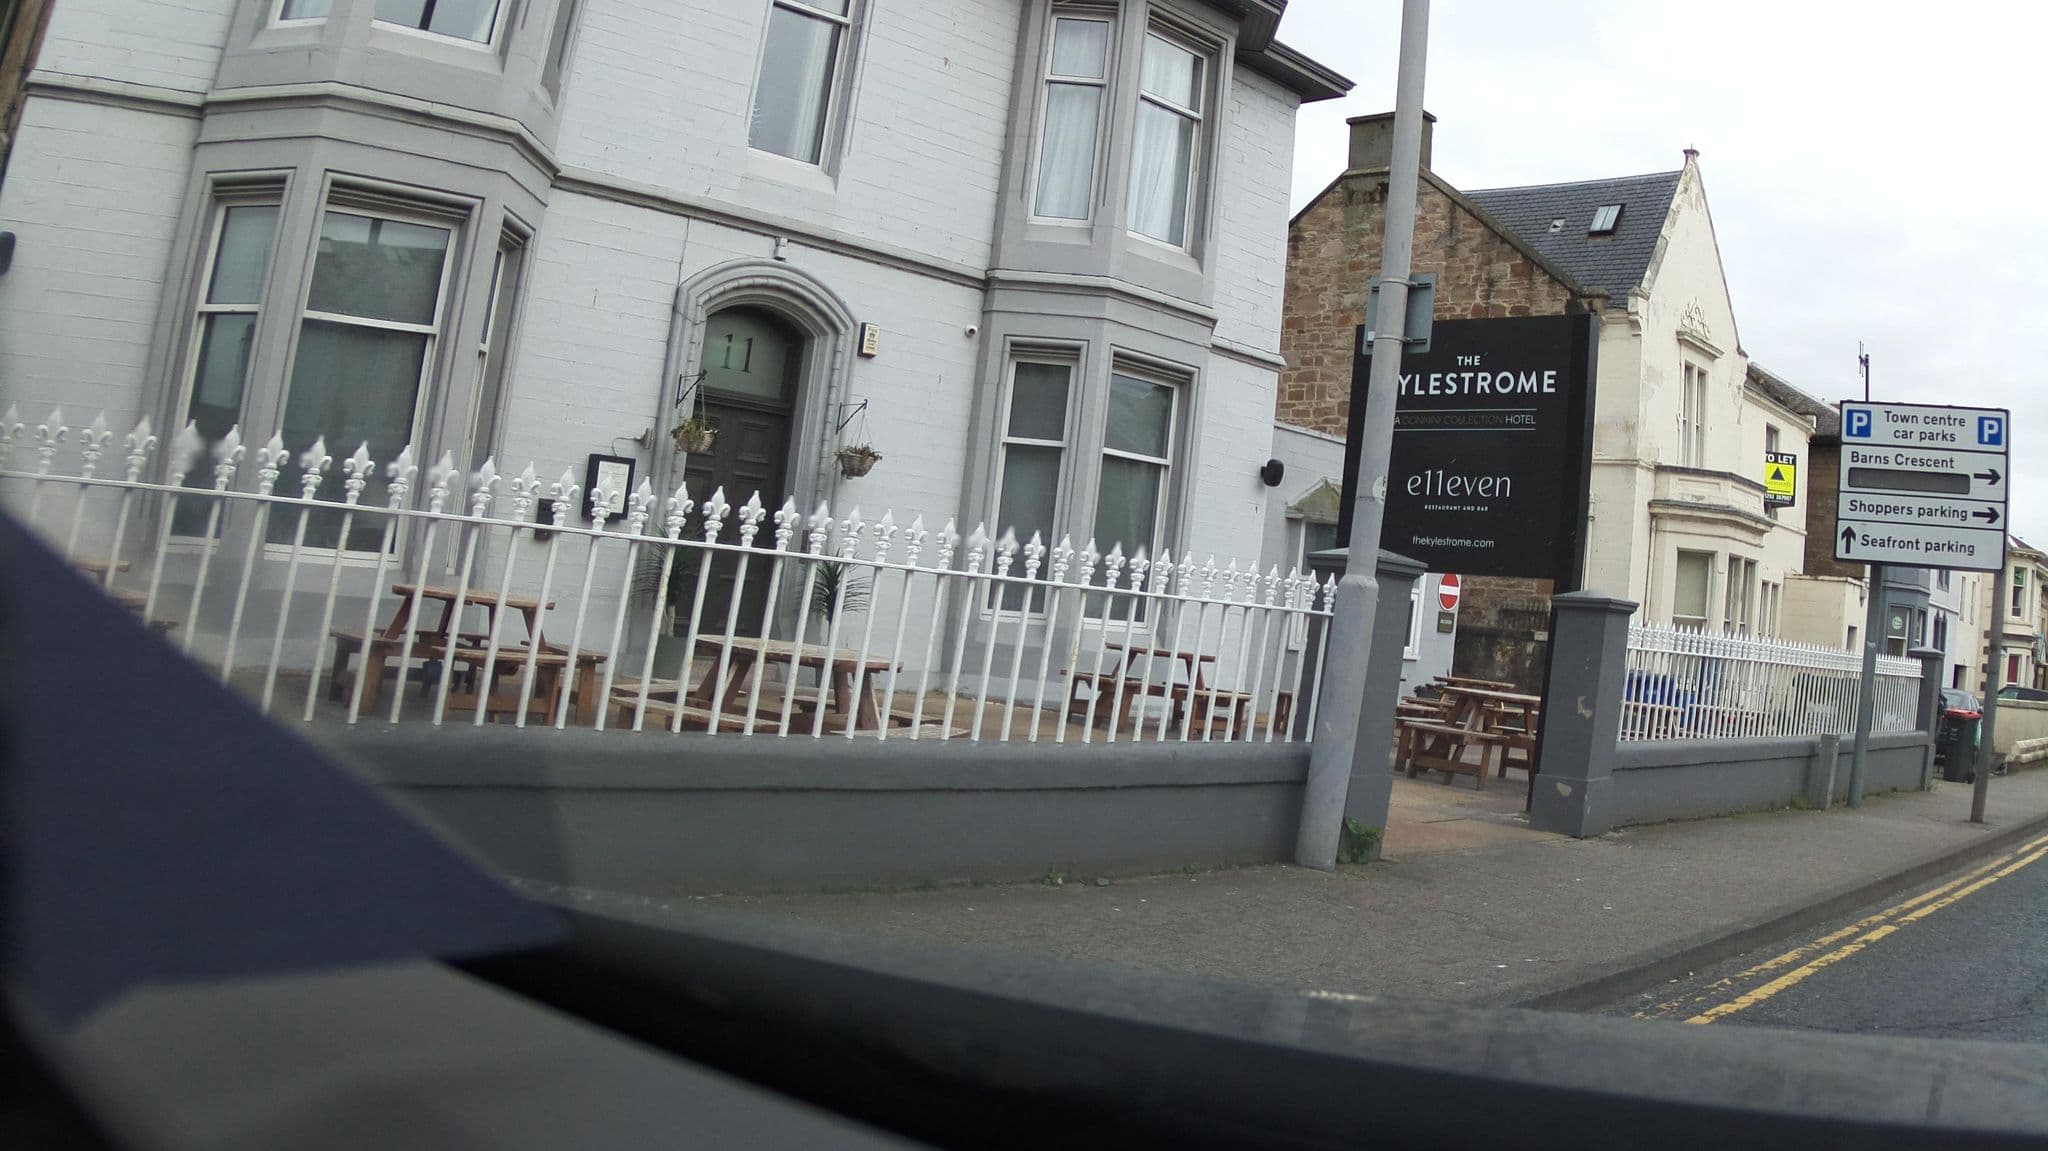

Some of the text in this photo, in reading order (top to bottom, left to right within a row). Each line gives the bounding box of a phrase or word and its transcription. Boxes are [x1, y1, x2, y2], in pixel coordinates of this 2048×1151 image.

[1457, 356, 1480, 366] THE
[1398, 371, 1557, 396] YLESTROME
[1443, 415, 1502, 424] COLLECTION
[1505, 415, 1536, 424] HOTEL
[1852, 412, 1867, 434] P
[1884, 411, 1966, 427] Town centre
[1893, 429, 1956, 442] car parks
[1984, 420, 1999, 442] P
[1778, 455, 1794, 464] LET
[1851, 451, 1955, 468] Barns Crescent
[1848, 500, 1968, 521] Shoppers parking
[1413, 536, 1494, 548] thekylestrome.com
[1861, 534, 1975, 556] Seafront parking
